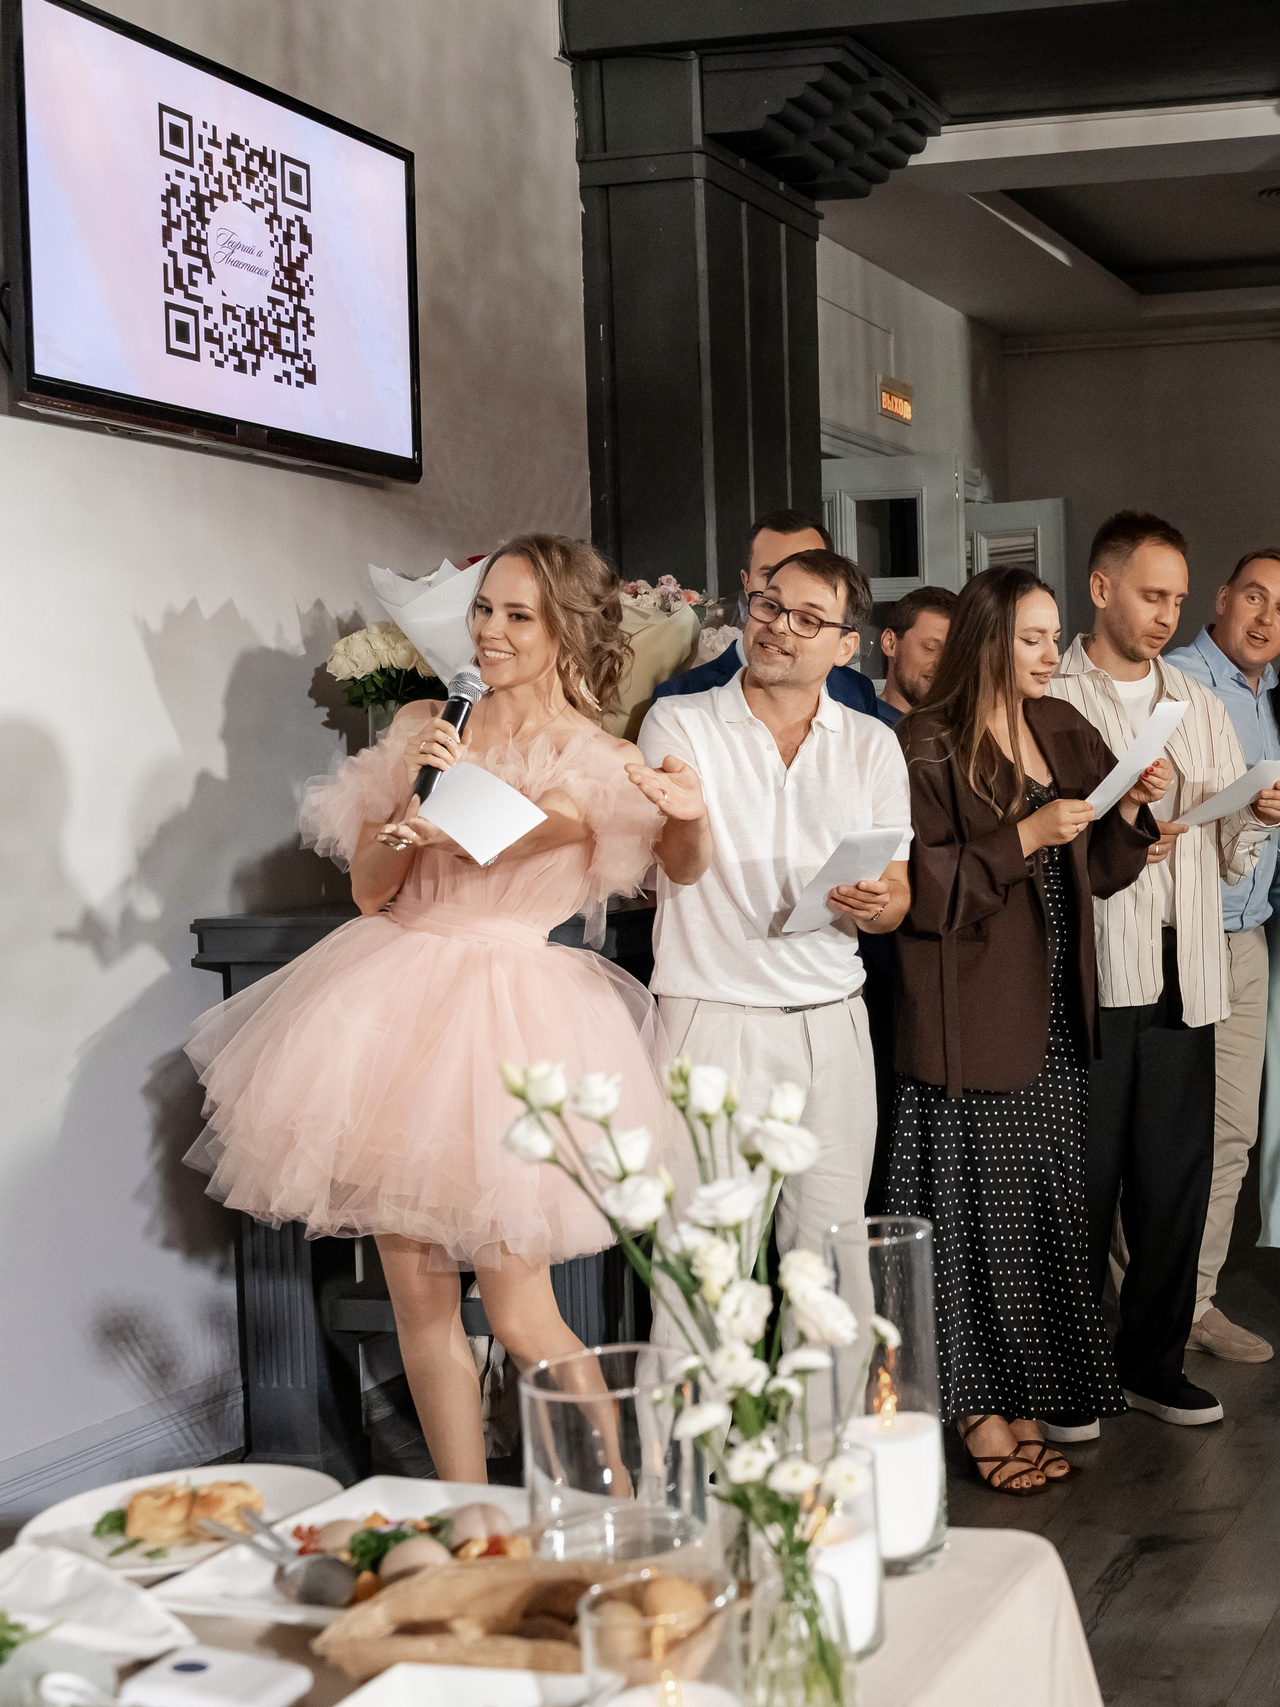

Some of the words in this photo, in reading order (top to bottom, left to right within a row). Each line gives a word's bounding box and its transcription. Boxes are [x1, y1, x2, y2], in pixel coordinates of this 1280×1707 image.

[216, 227, 256, 255] Георгий
[256, 249, 264, 258] и
[213, 246, 270, 277] Анастасия
